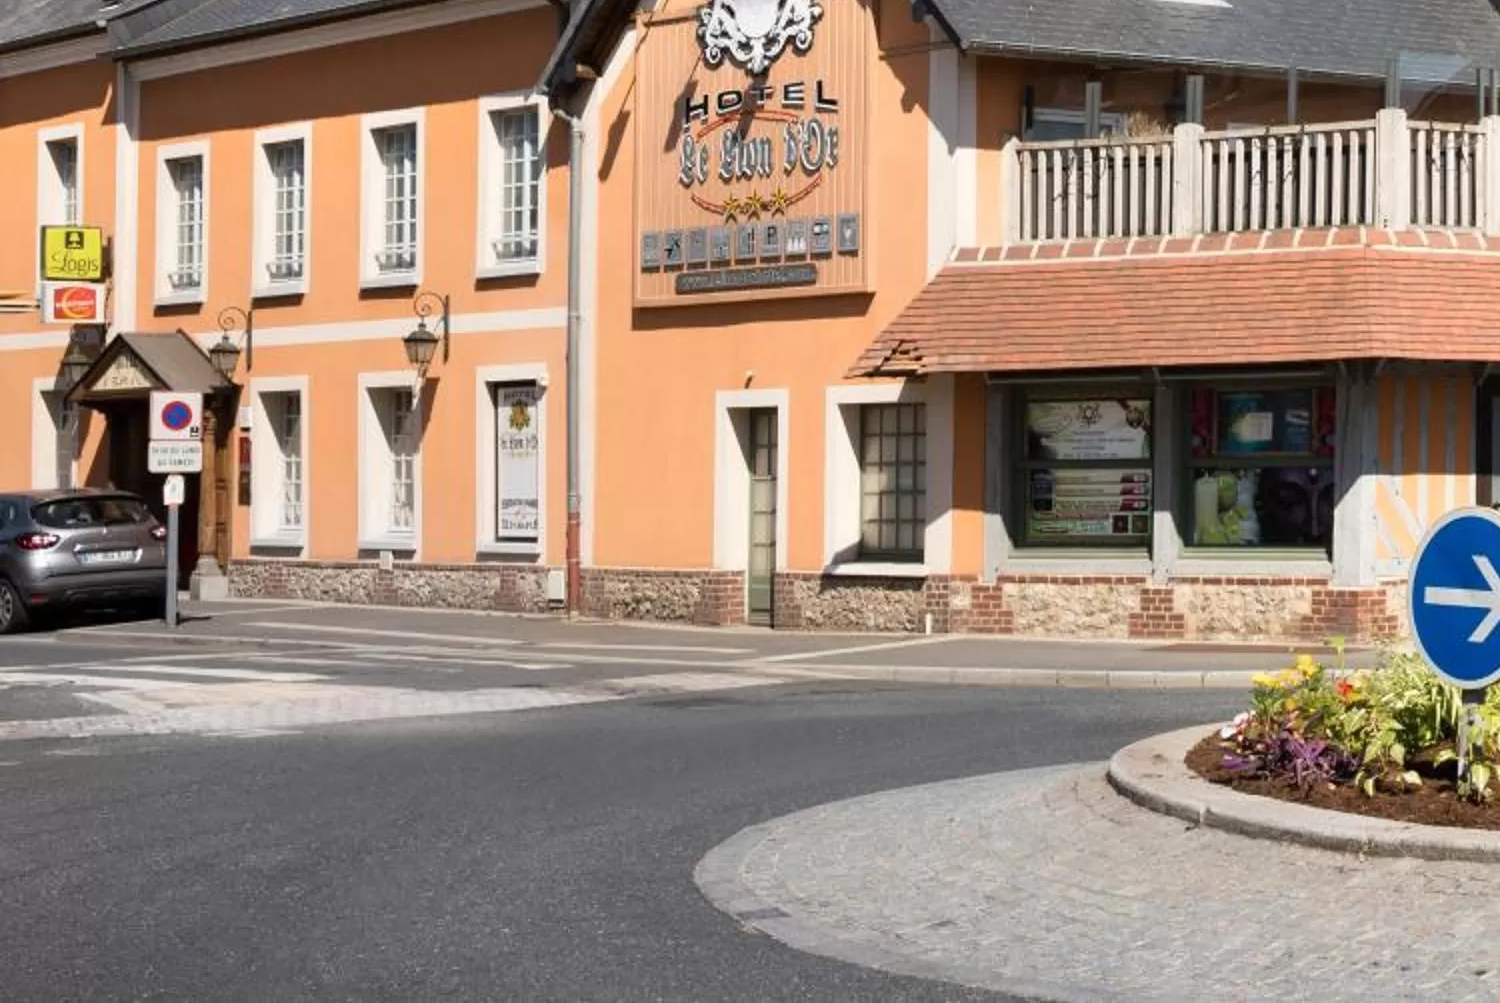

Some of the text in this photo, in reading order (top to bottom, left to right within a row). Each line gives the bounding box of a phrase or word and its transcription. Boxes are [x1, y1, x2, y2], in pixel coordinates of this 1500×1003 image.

[683, 80, 838, 131] HOTEL
[679, 118, 839, 186] Le Lion d'Or
[50, 250, 99, 276] Logis
